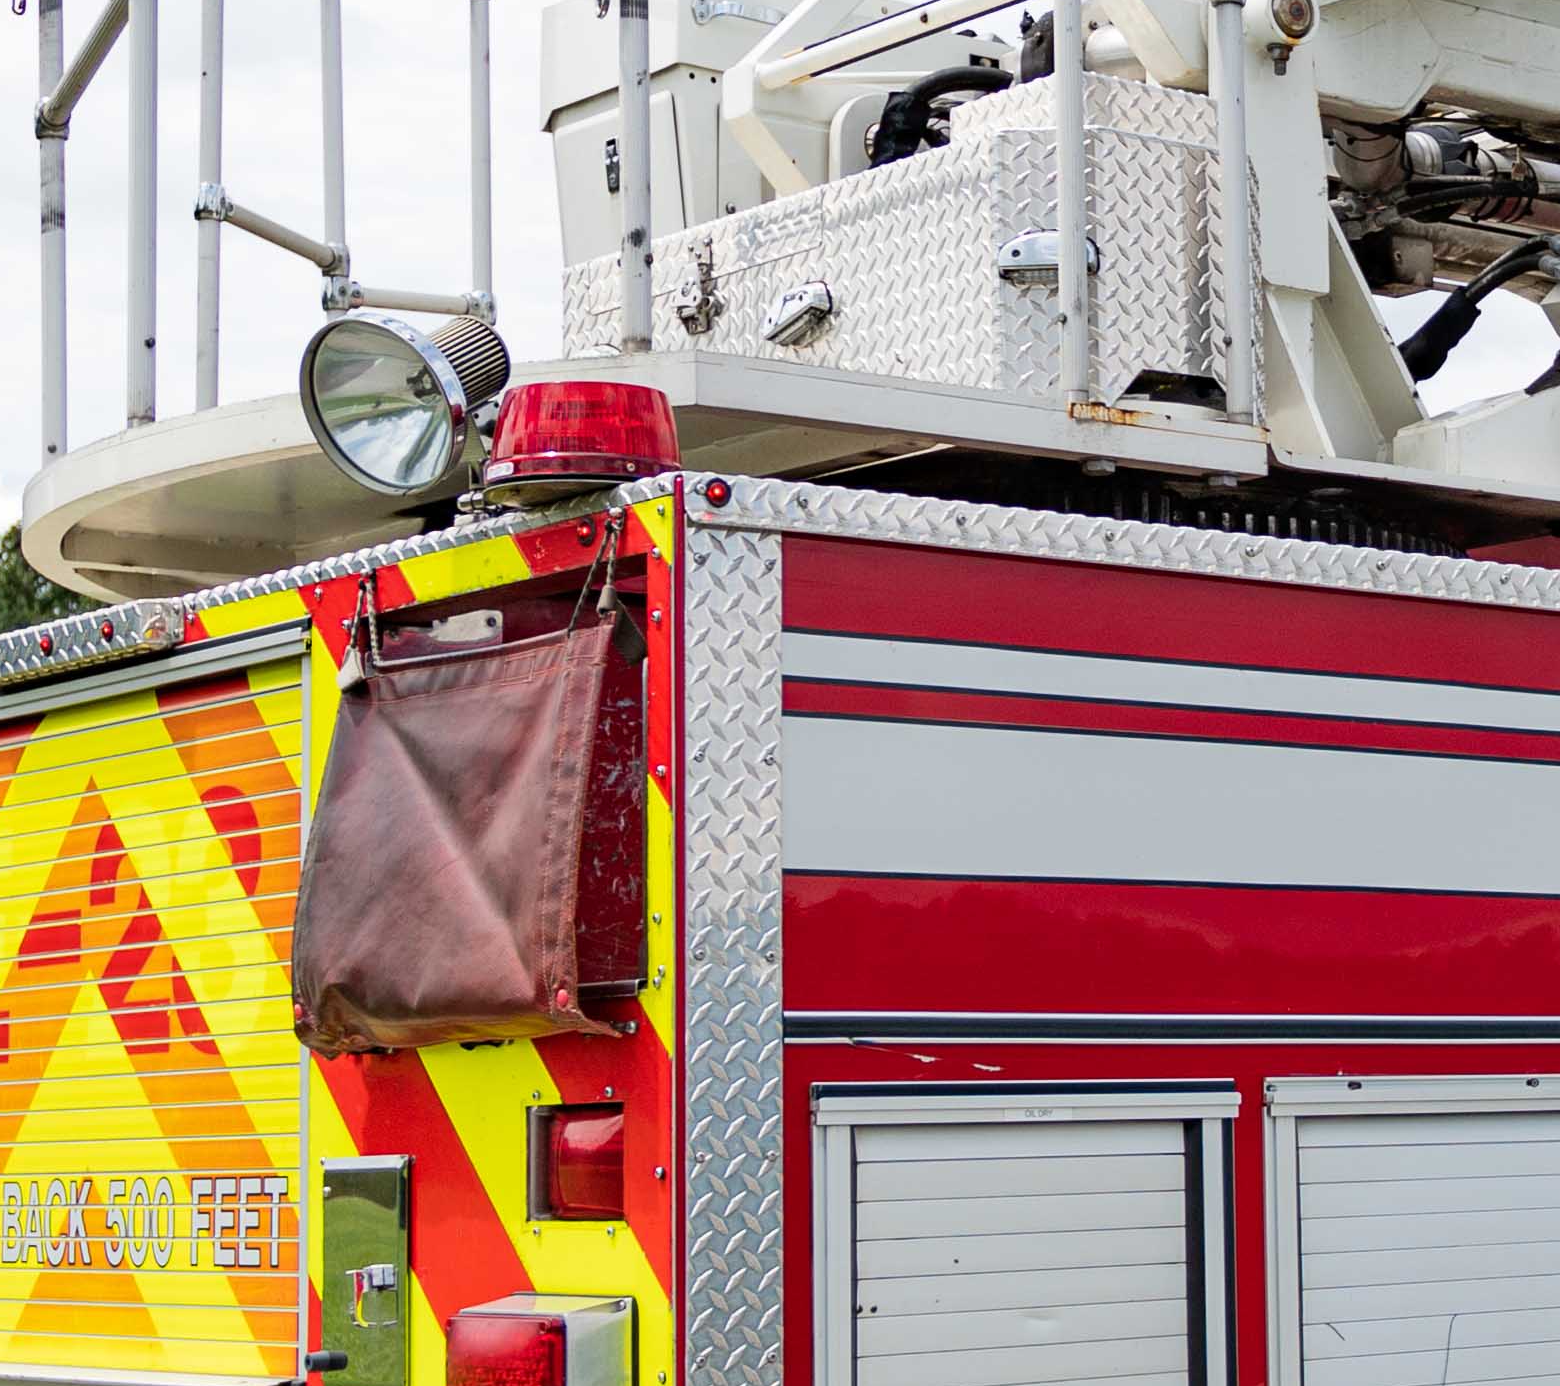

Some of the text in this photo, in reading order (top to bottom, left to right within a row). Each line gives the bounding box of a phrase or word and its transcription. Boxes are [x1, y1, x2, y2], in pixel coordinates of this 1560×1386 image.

[1, 1177, 93, 1265] BACK
[105, 1176, 175, 1268] 500
[191, 1175, 288, 1268] FEET
